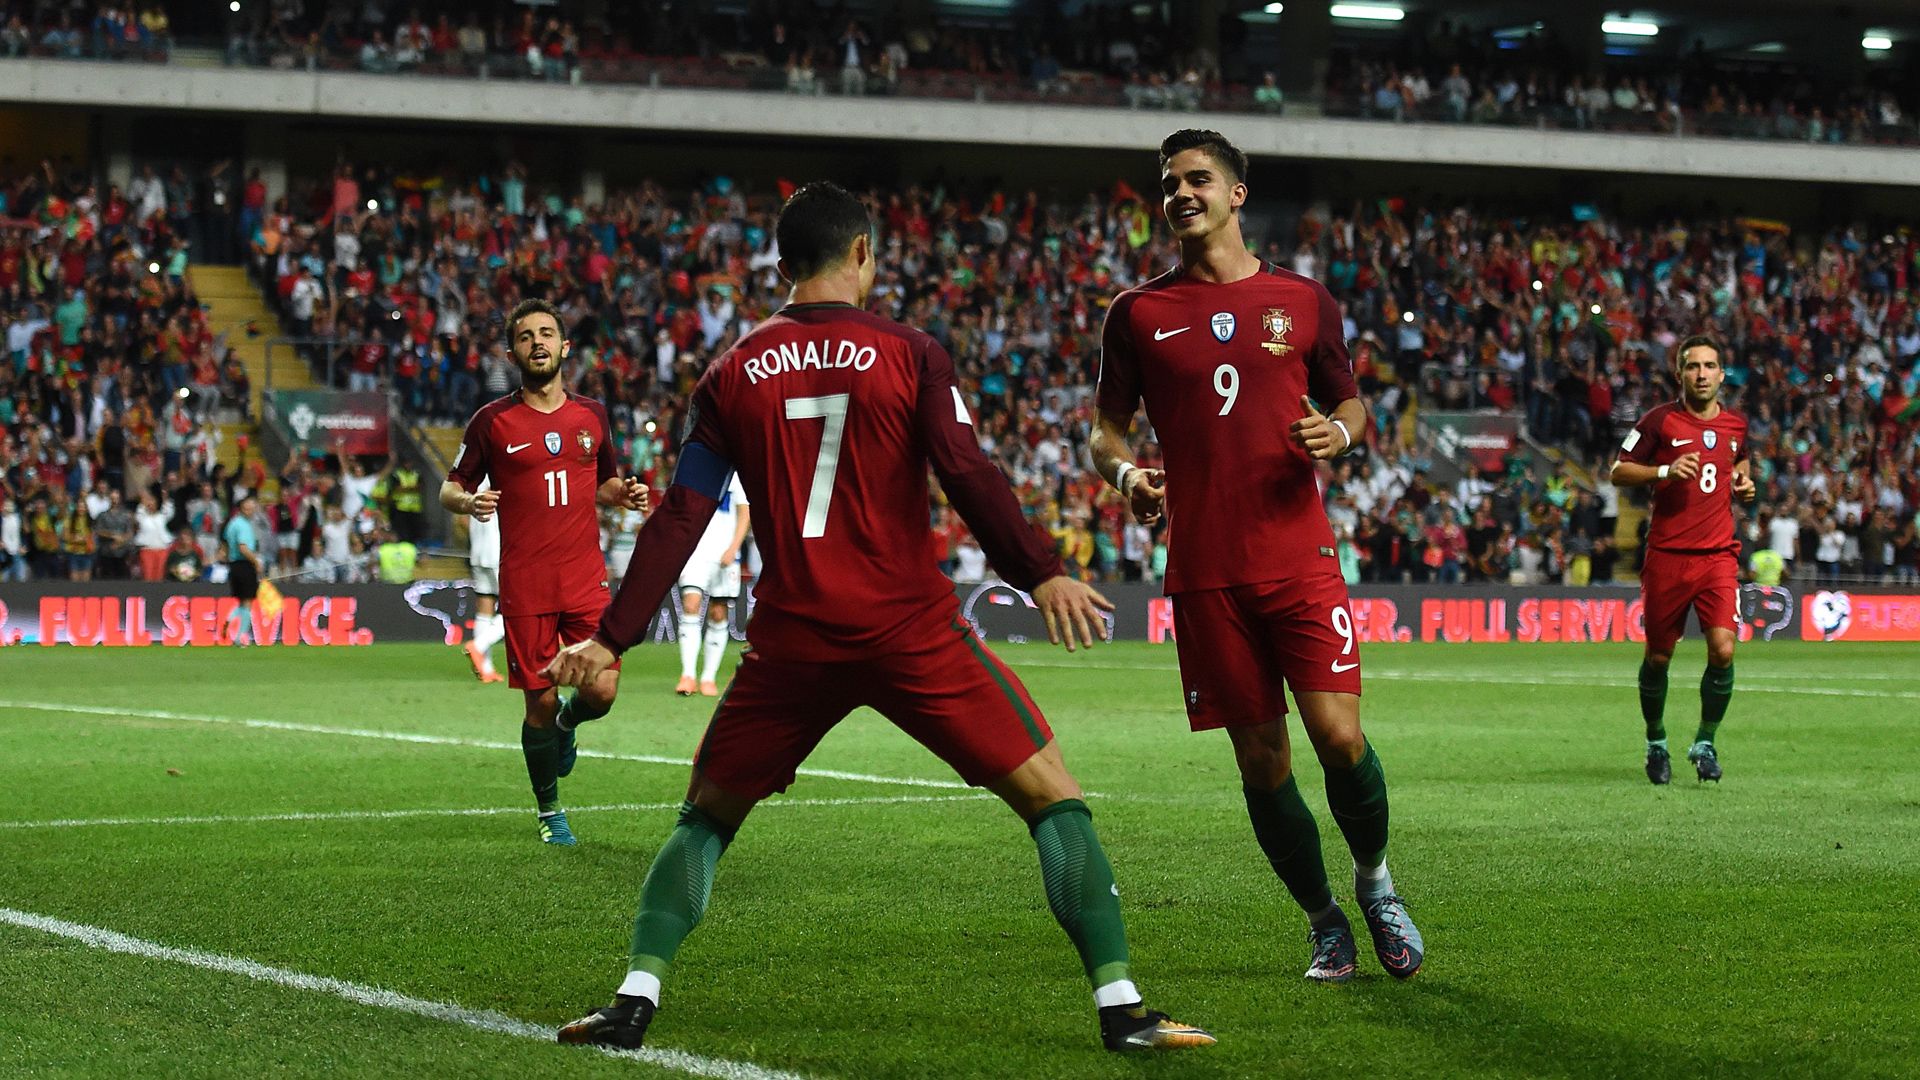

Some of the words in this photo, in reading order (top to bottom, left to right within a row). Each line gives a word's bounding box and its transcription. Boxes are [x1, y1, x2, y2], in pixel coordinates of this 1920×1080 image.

[744, 340, 877, 384] RONALDO
[1213, 363, 1240, 416] 9
[543, 470, 569, 507] 11
[785, 393, 849, 538] 7
[1700, 462, 1717, 494] 8
[40, 596, 151, 647] FULL
[1331, 605, 1354, 655] 9
[1421, 597, 1511, 643] FULL
[1517, 598, 1647, 643] SERVIC
